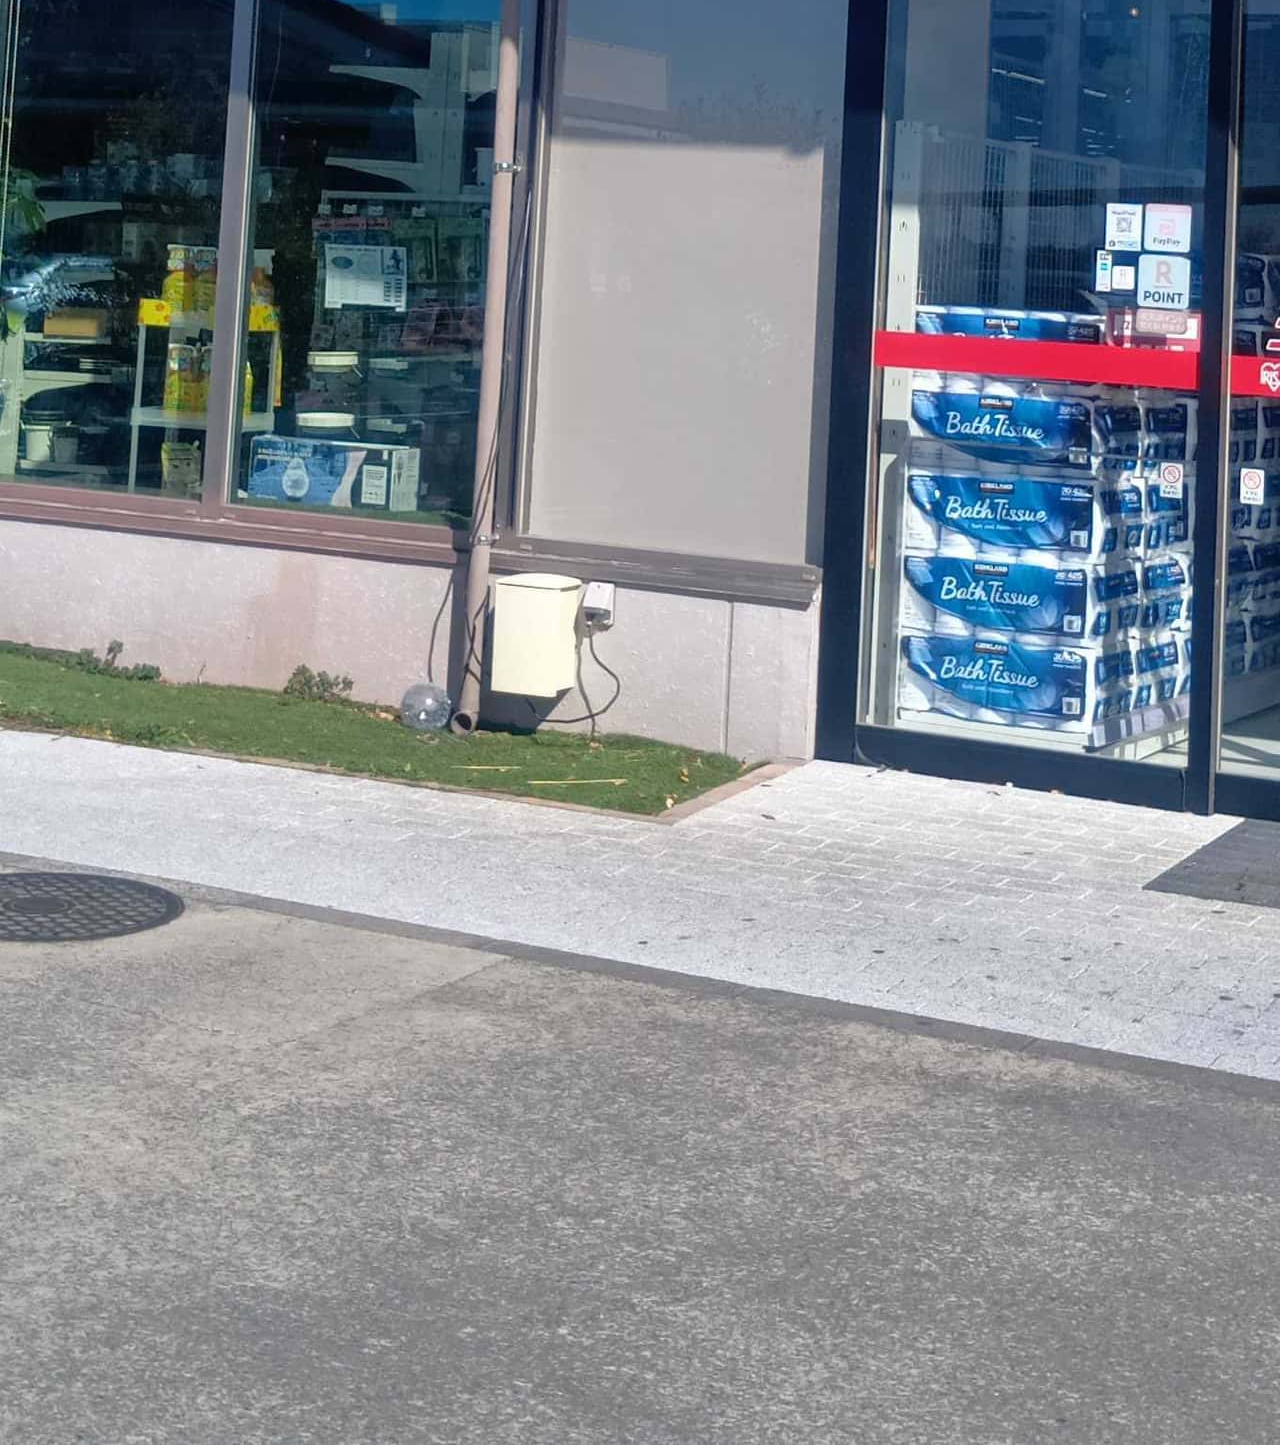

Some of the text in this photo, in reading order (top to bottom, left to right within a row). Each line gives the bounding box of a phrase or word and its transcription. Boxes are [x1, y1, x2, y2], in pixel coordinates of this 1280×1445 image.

[1143, 290, 1184, 305] POINT
[945, 411, 1045, 439] Bath Tissue
[945, 495, 1048, 523] Bath Tissue
[940, 576, 1040, 607] Bath Tissue
[940, 655, 988, 680] Bath
[987, 659, 1039, 688] Tissue
